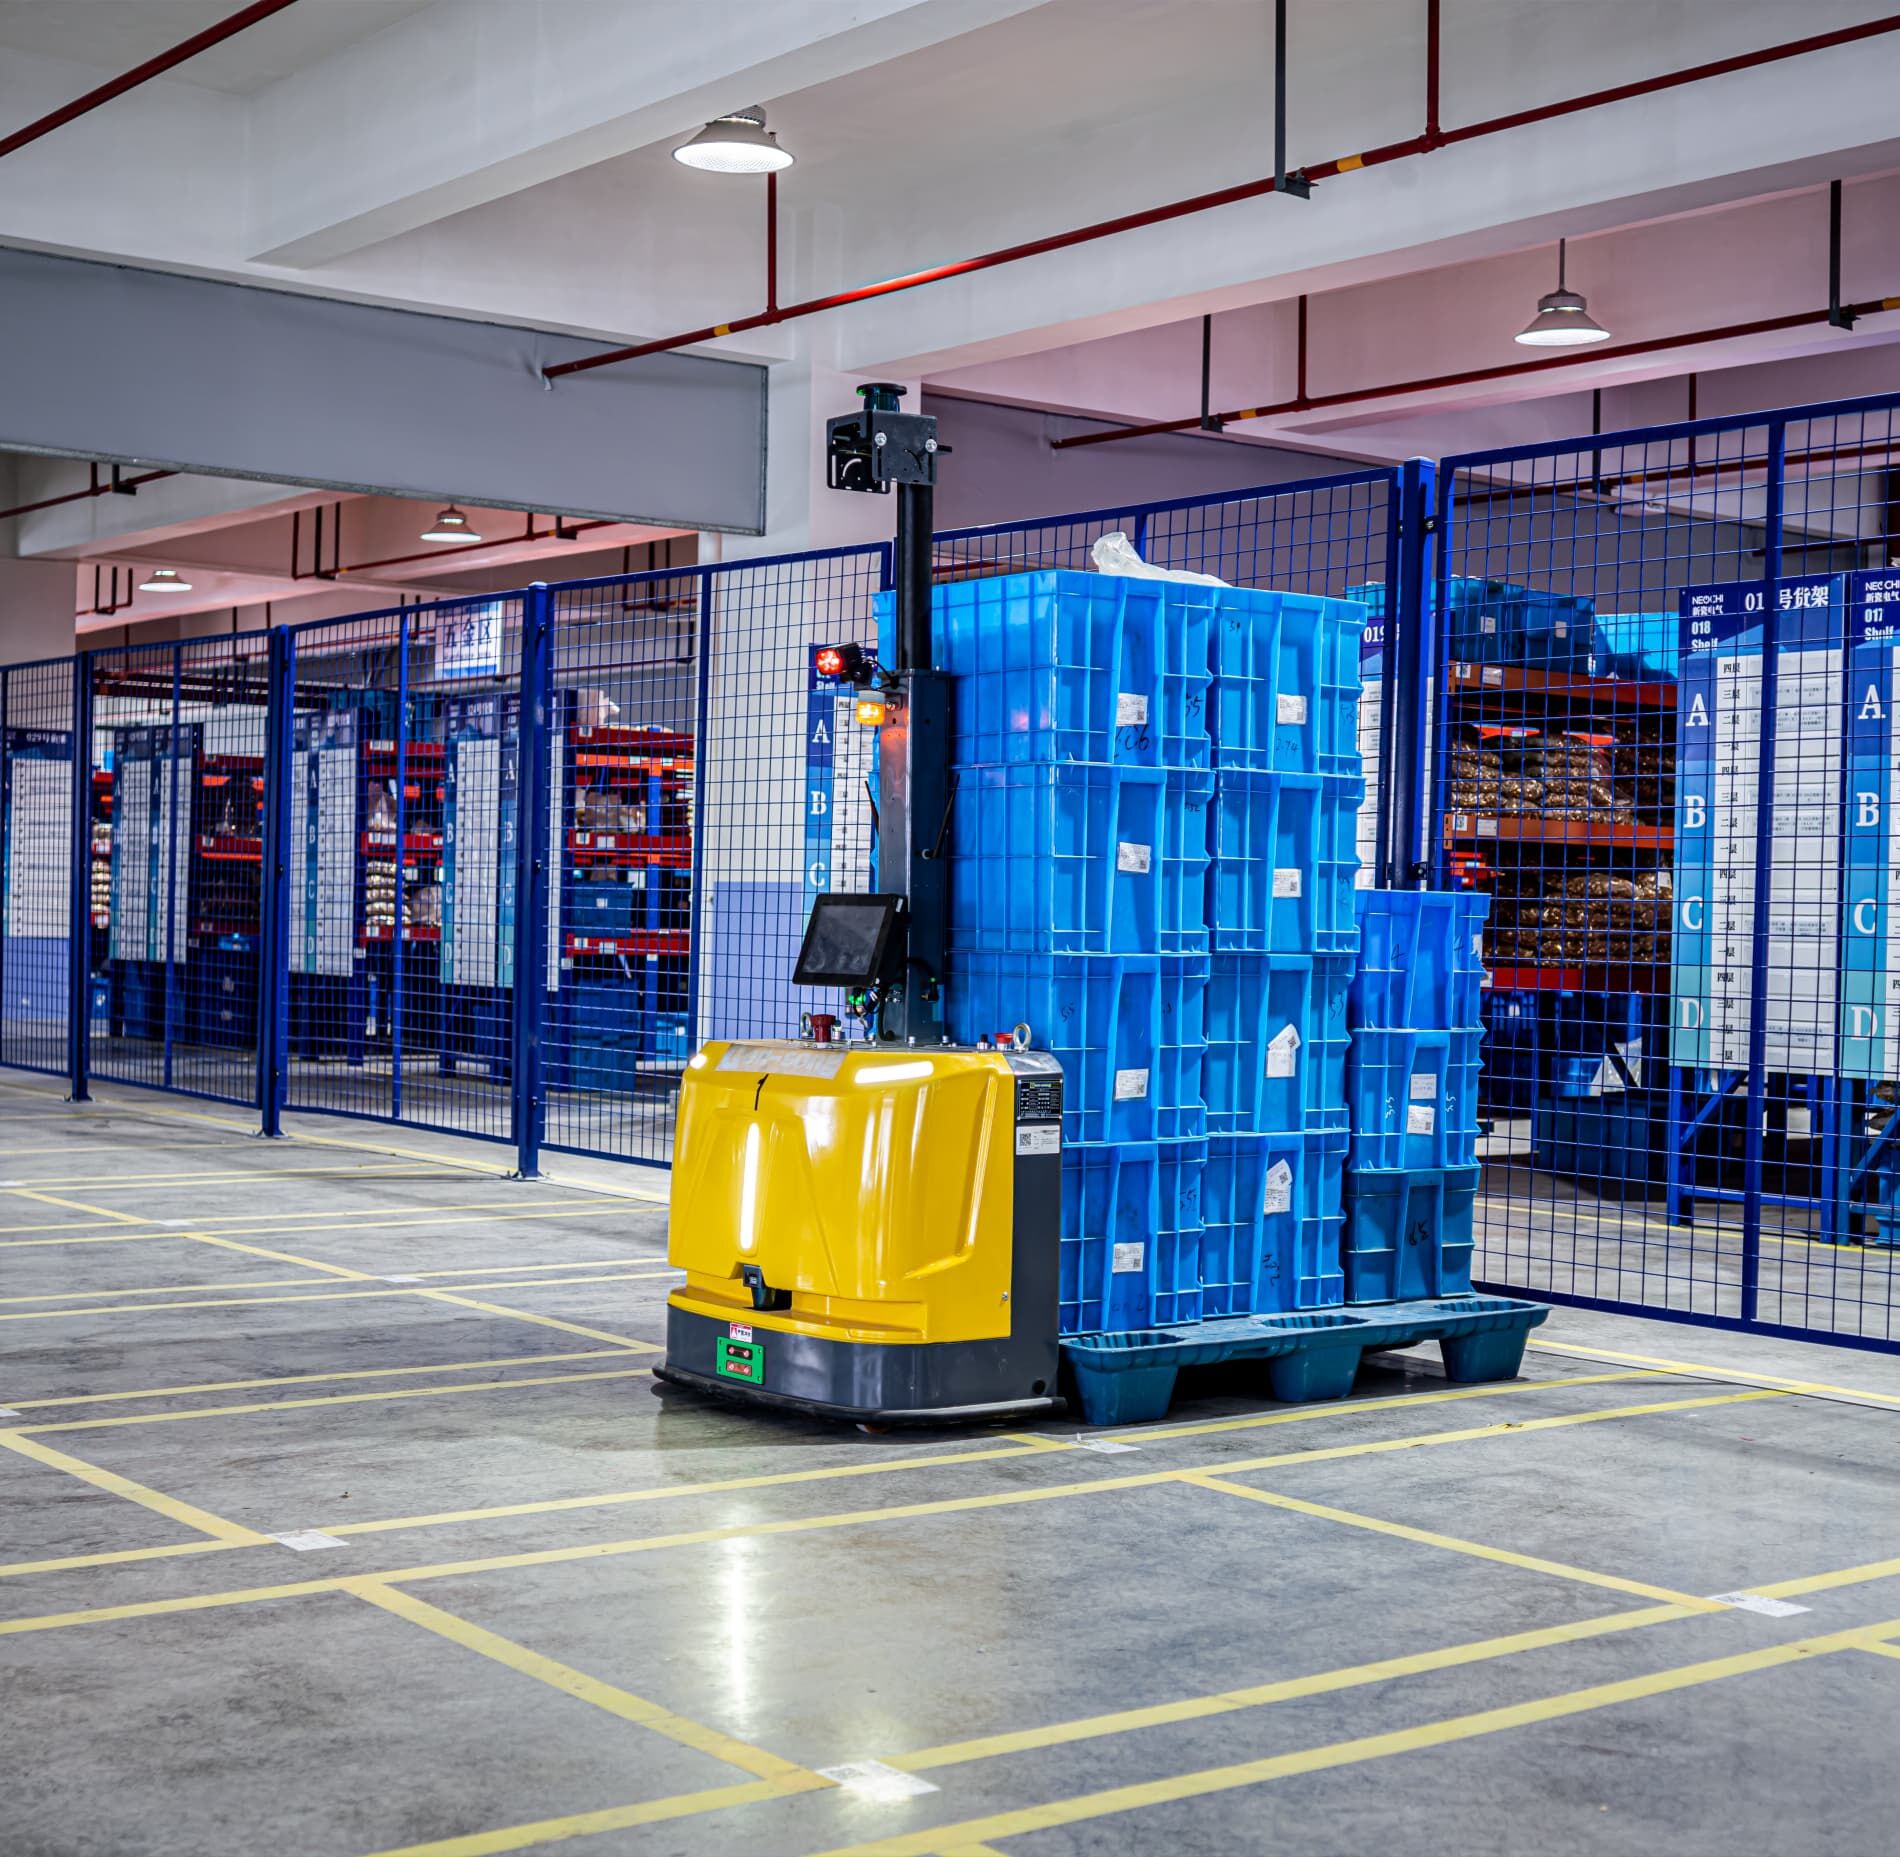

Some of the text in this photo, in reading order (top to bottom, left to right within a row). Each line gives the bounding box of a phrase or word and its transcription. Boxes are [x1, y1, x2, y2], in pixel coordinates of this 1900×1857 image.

[1744, 586, 1829, 611] 01号货架
[1691, 620, 1711, 635] 018
[1864, 608, 1883, 623] 017
[1691, 638, 1719, 652] Shelf
[1684, 693, 1712, 727] A
[1857, 684, 1886, 719] A
[811, 719, 831, 743] A
[810, 791, 827, 815] B
[1683, 795, 1706, 829] B
[1856, 791, 1880, 827] B
[808, 862, 825, 887] C
[1682, 895, 1703, 930] C
[1853, 898, 1877, 934] C
[1680, 998, 1704, 1030] D
[1850, 1006, 1878, 1041] D
